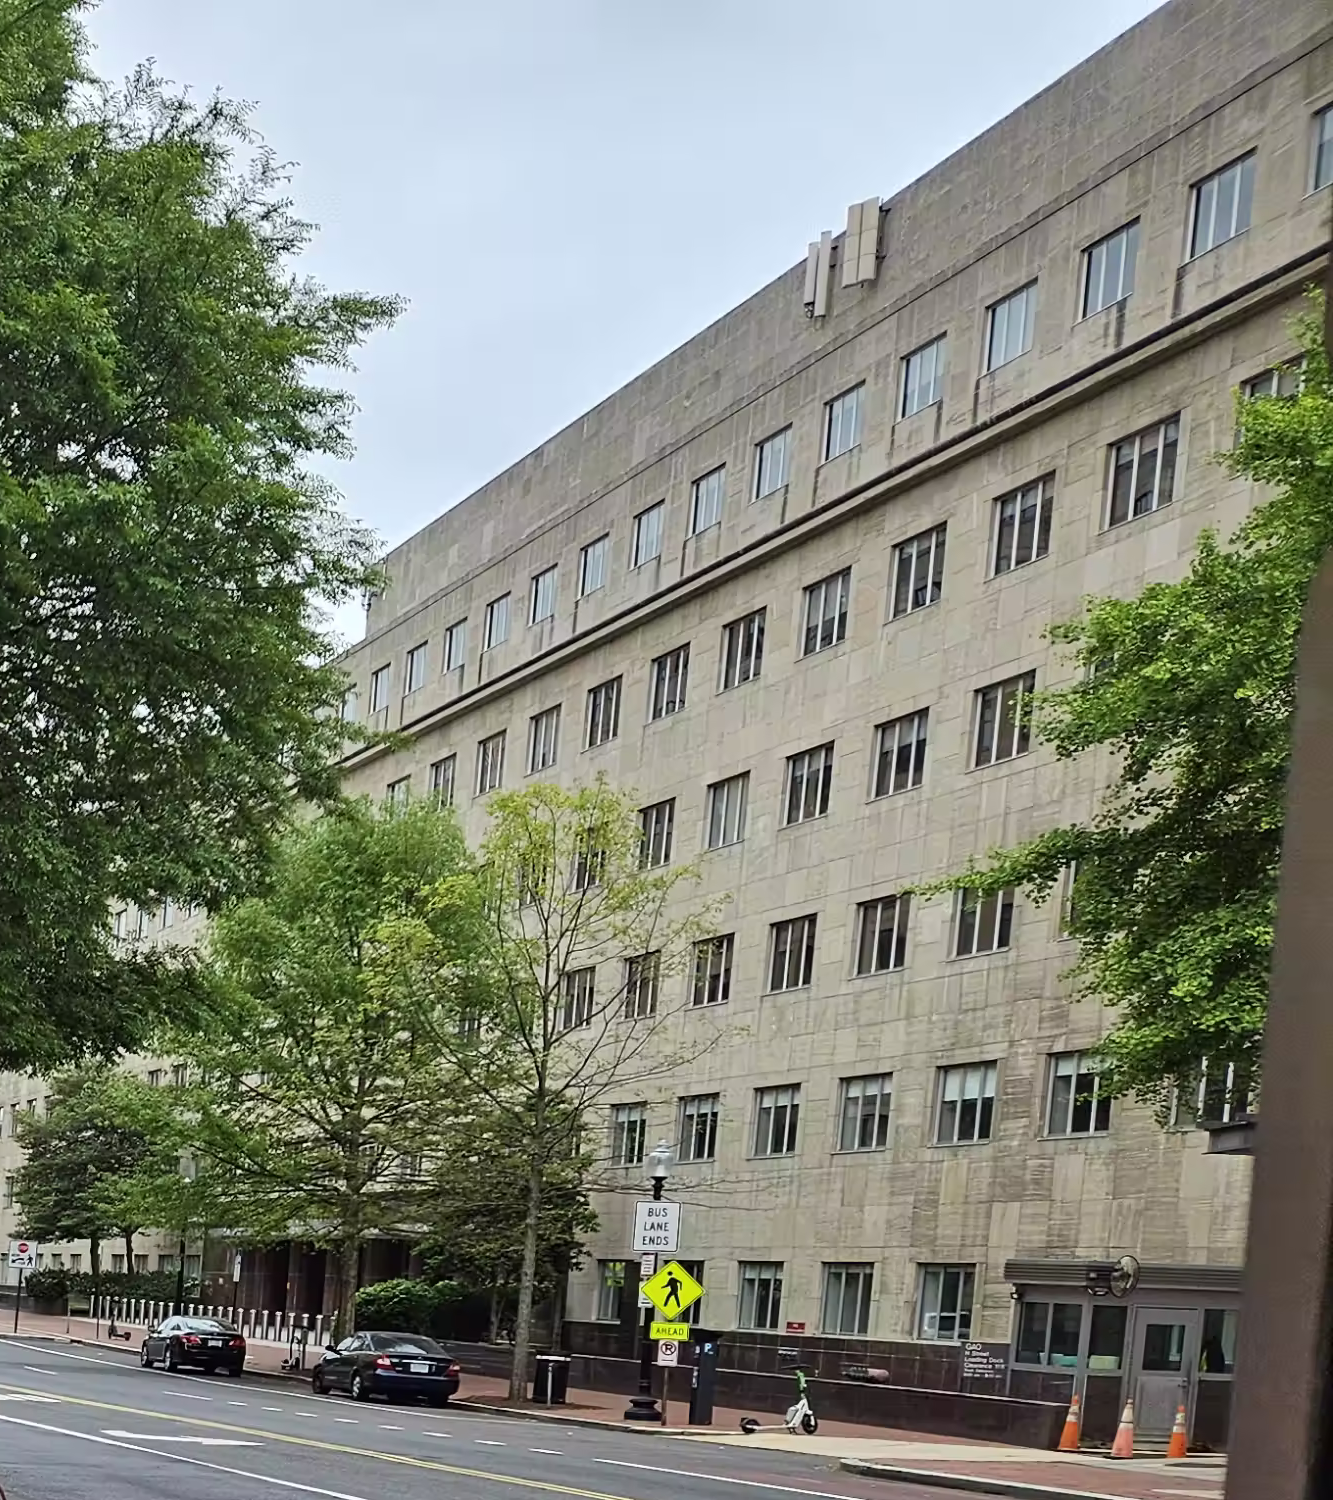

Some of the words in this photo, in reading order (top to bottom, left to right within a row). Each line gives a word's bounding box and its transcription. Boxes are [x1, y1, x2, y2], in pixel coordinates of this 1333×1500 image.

[647, 1207, 668, 1218] BUS
[644, 1222, 669, 1232] LANE
[642, 1236, 669, 1246] ENDS
[655, 1327, 684, 1337] AHEAD
